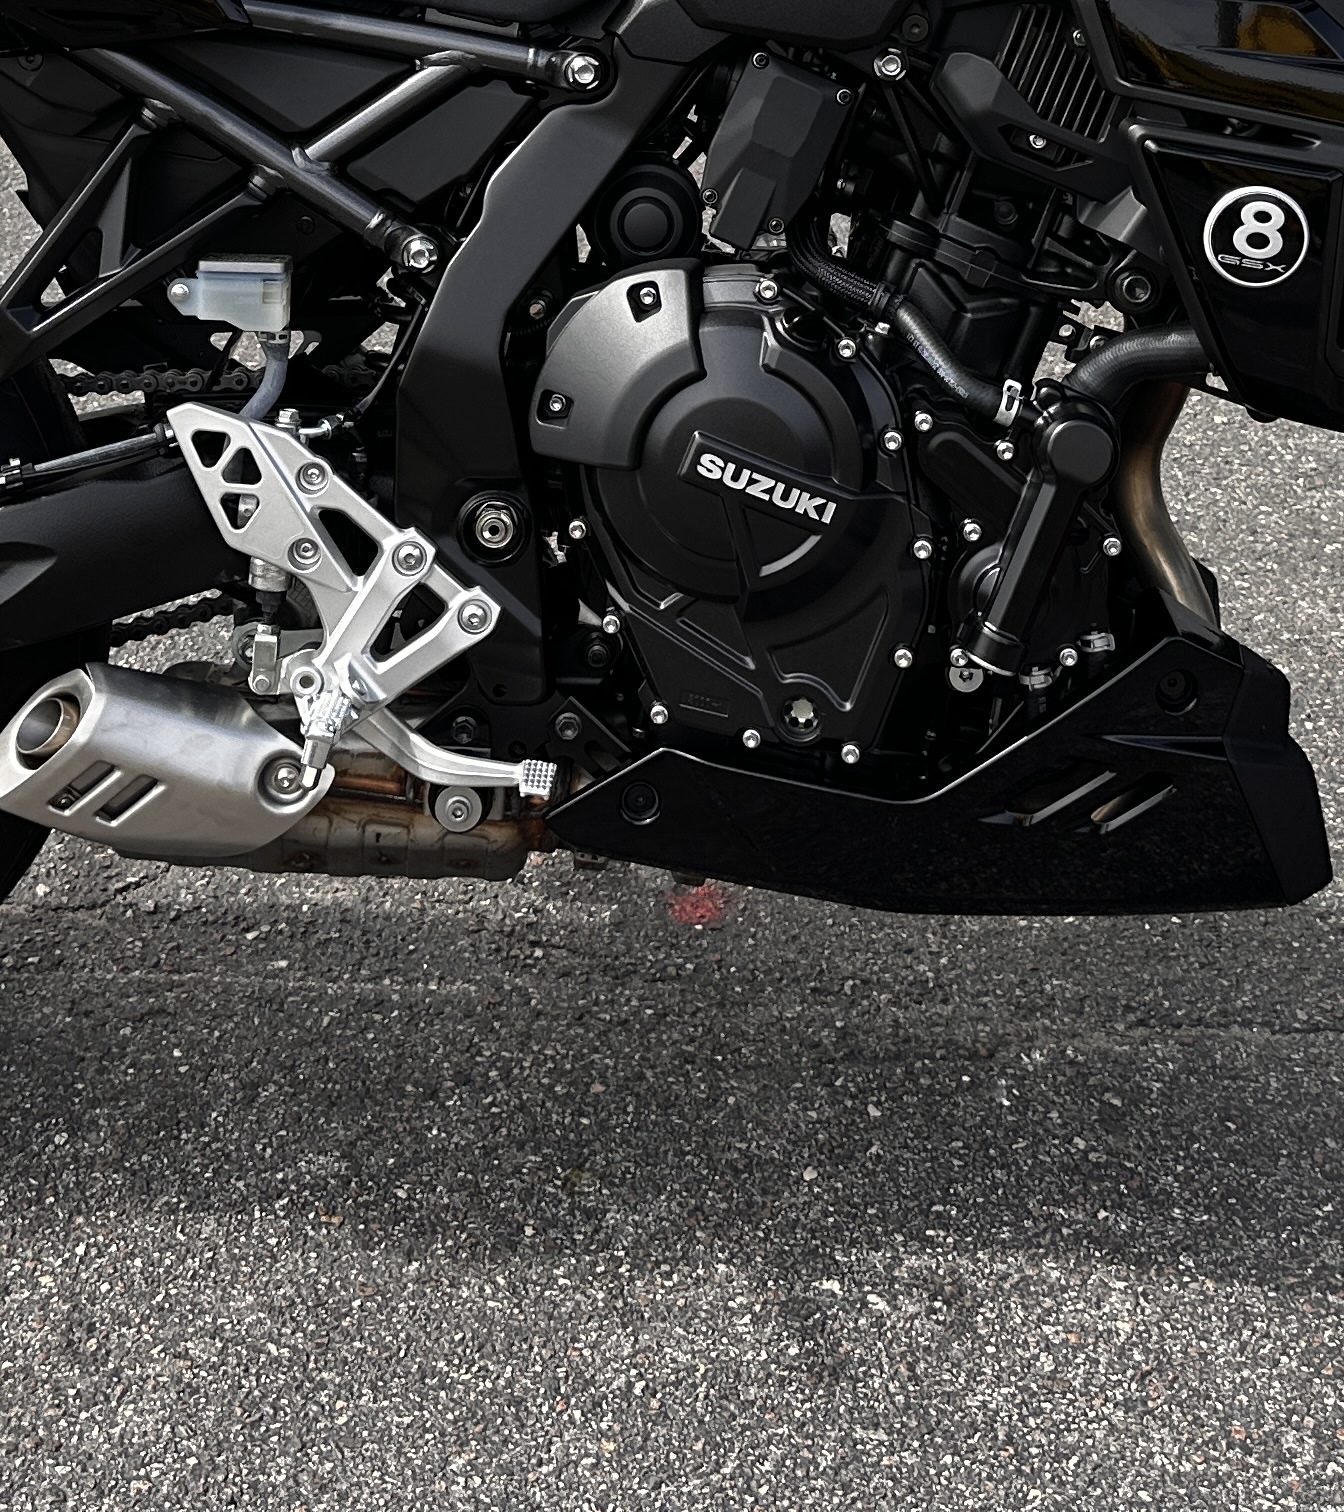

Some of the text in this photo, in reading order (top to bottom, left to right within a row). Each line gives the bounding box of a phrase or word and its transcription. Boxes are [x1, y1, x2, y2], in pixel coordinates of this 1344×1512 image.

[1232, 201, 1286, 260] 8
[1218, 254, 1287, 273] GSX
[696, 452, 837, 526] SUZUKI
